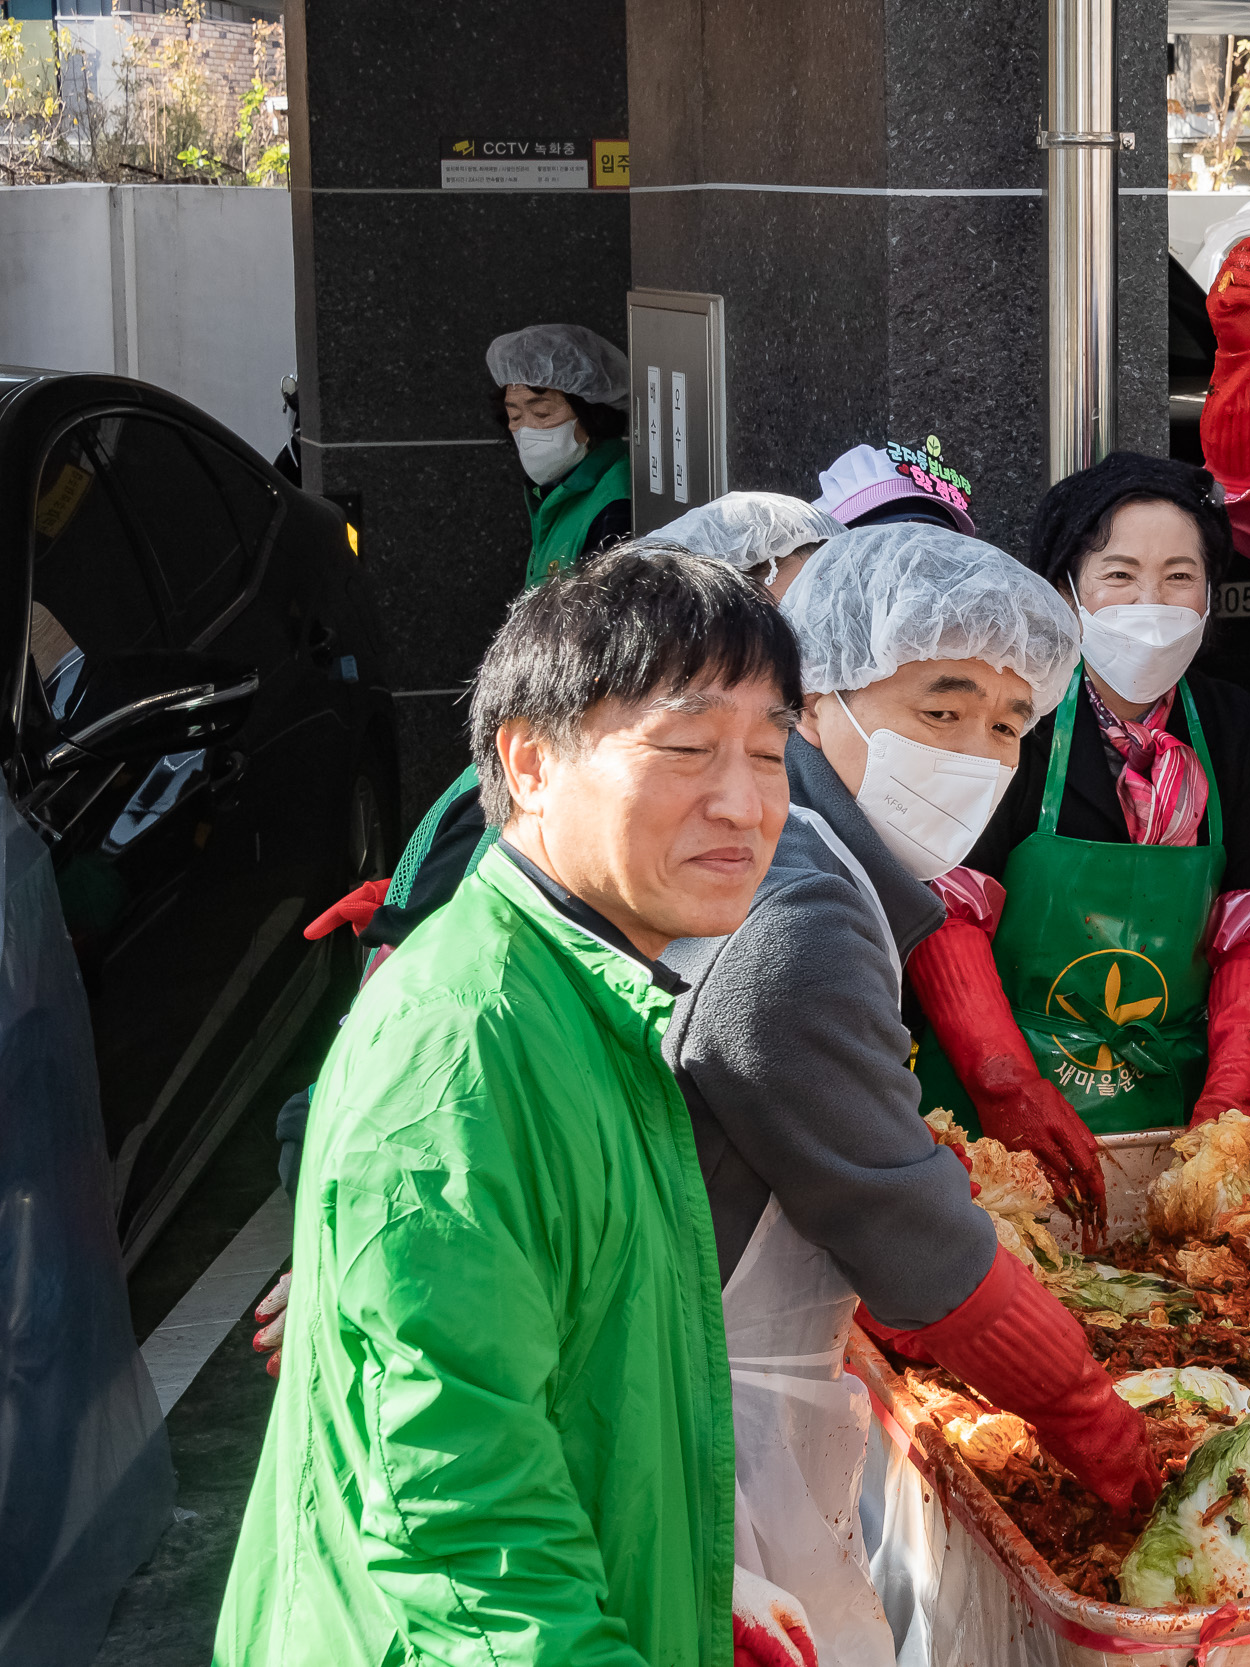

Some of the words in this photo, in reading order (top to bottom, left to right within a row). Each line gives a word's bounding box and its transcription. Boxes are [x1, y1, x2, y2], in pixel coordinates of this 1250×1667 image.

[483, 142, 529, 155] CCTV
[534, 142, 575, 155] 녹화중
[887, 441, 928, 471] 군자동
[928, 456, 972, 495] 부녀회장
[883, 794, 908, 815] KF94
